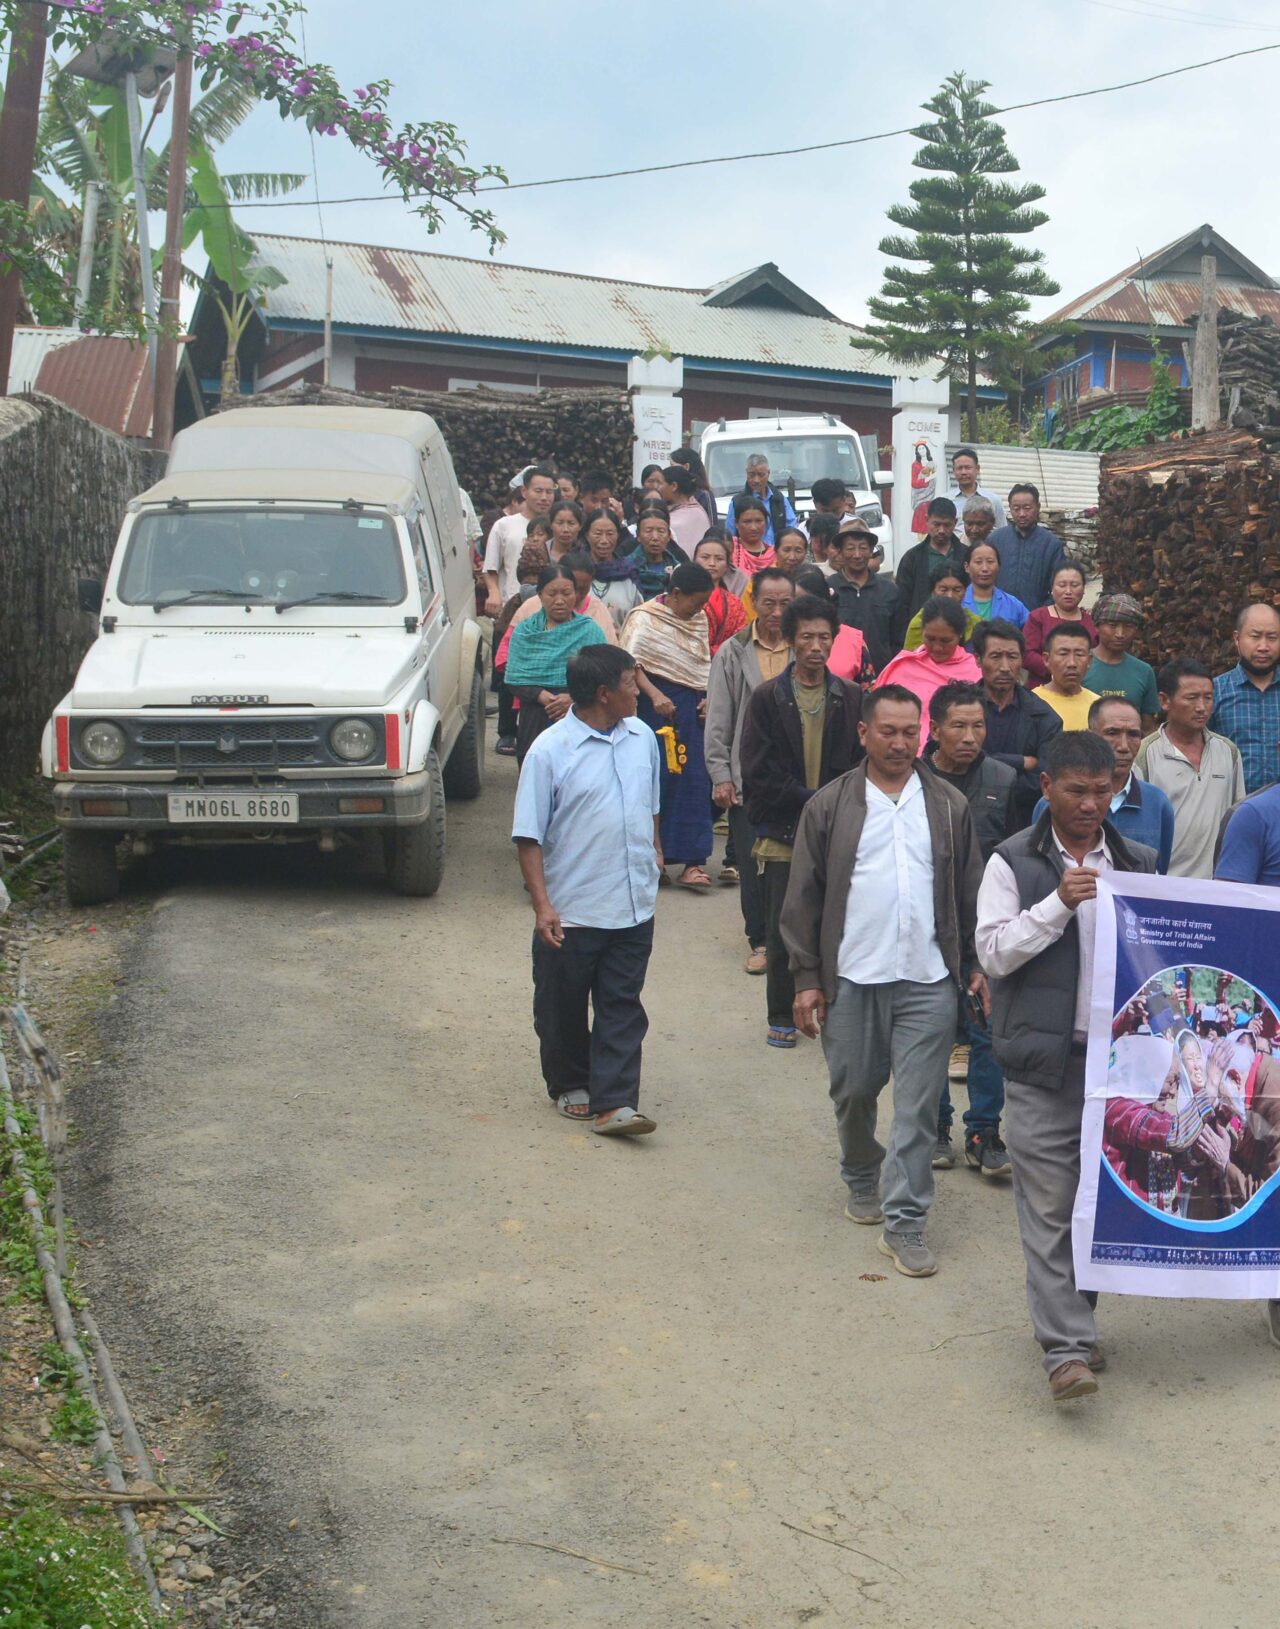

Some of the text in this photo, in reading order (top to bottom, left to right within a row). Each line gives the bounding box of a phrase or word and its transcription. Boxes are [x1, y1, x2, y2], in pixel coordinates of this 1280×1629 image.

[908, 421, 941, 433] COME
[191, 695, 269, 704] MARUTI
[185, 800, 290, 817] MN06L 8680
[1140, 928, 1164, 938] Ministry
[1174, 931, 1193, 940] Tribal
[1193, 933, 1216, 942] Affairs
[1140, 937, 1177, 947] Government
